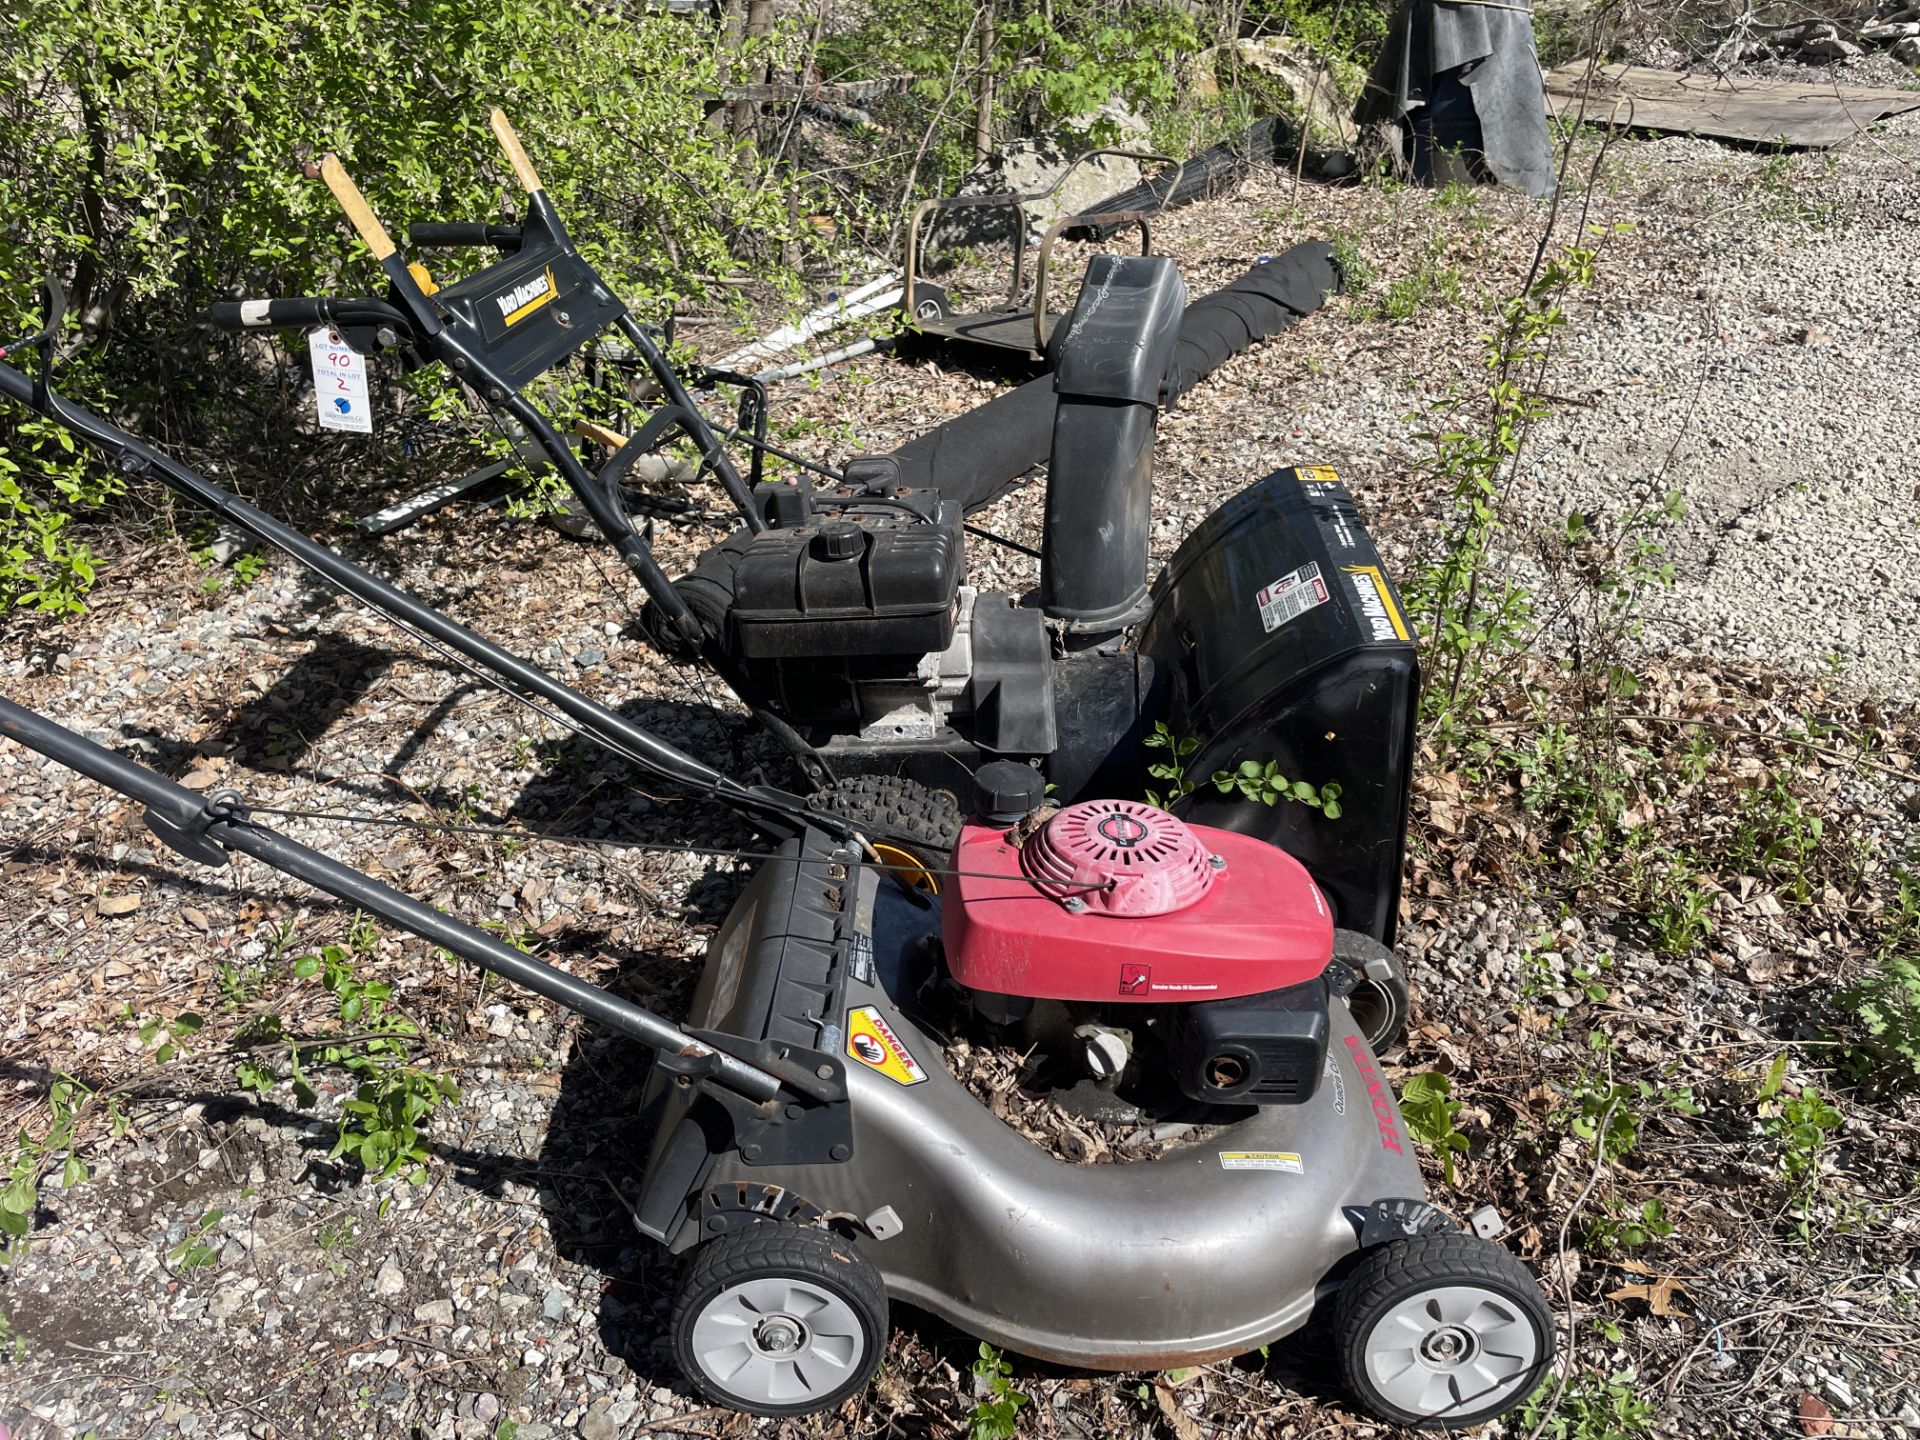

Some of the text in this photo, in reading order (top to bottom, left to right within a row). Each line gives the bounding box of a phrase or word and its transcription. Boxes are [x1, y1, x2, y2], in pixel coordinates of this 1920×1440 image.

[328, 352, 350, 367] 90
[336, 377, 352, 392] 2
[873, 1019, 914, 1068] DANGER
[1344, 1034, 1403, 1155] HONDA
